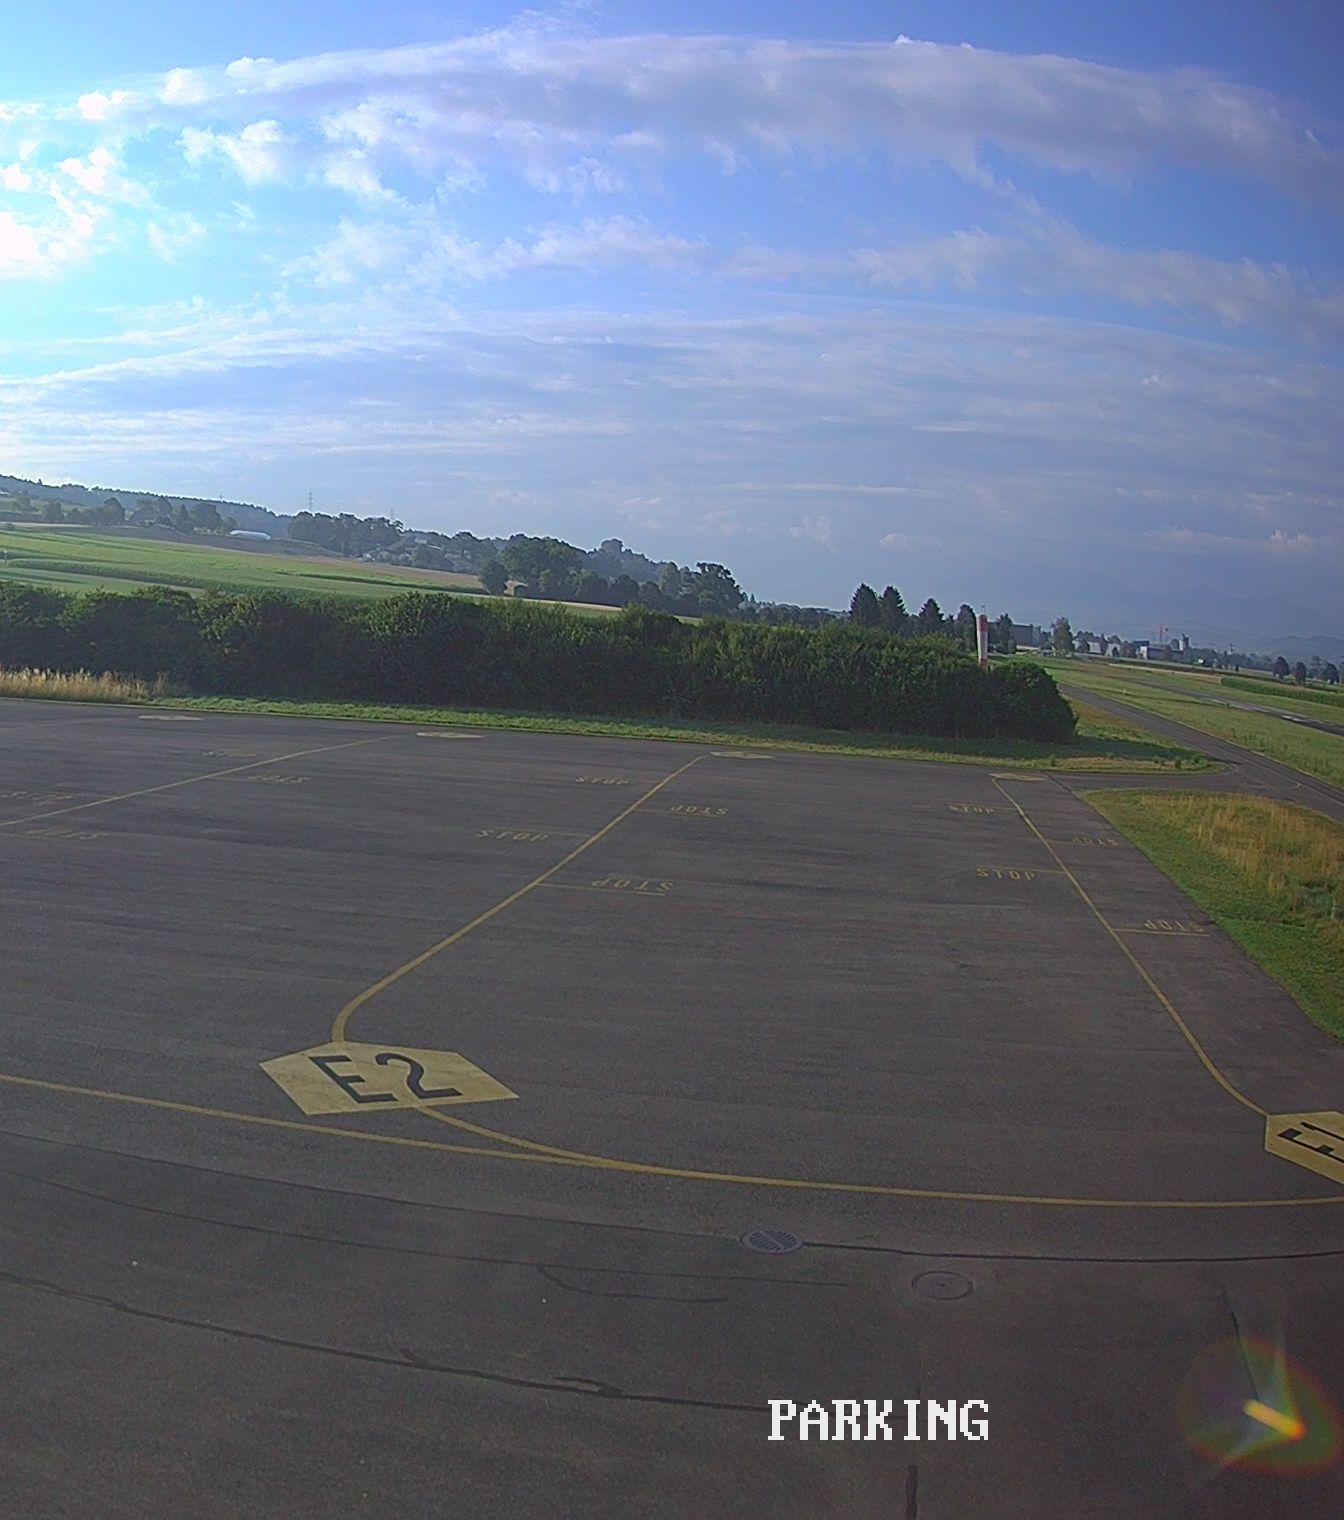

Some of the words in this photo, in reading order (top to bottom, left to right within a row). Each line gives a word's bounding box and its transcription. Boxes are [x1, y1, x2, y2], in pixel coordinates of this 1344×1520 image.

[669, 804, 729, 816] STOP
[476, 828, 553, 842] STOP
[976, 867, 1035, 881] STOP
[591, 878, 675, 893] STOP
[1144, 918, 1205, 933] STOP
[308, 1052, 463, 1104] E2
